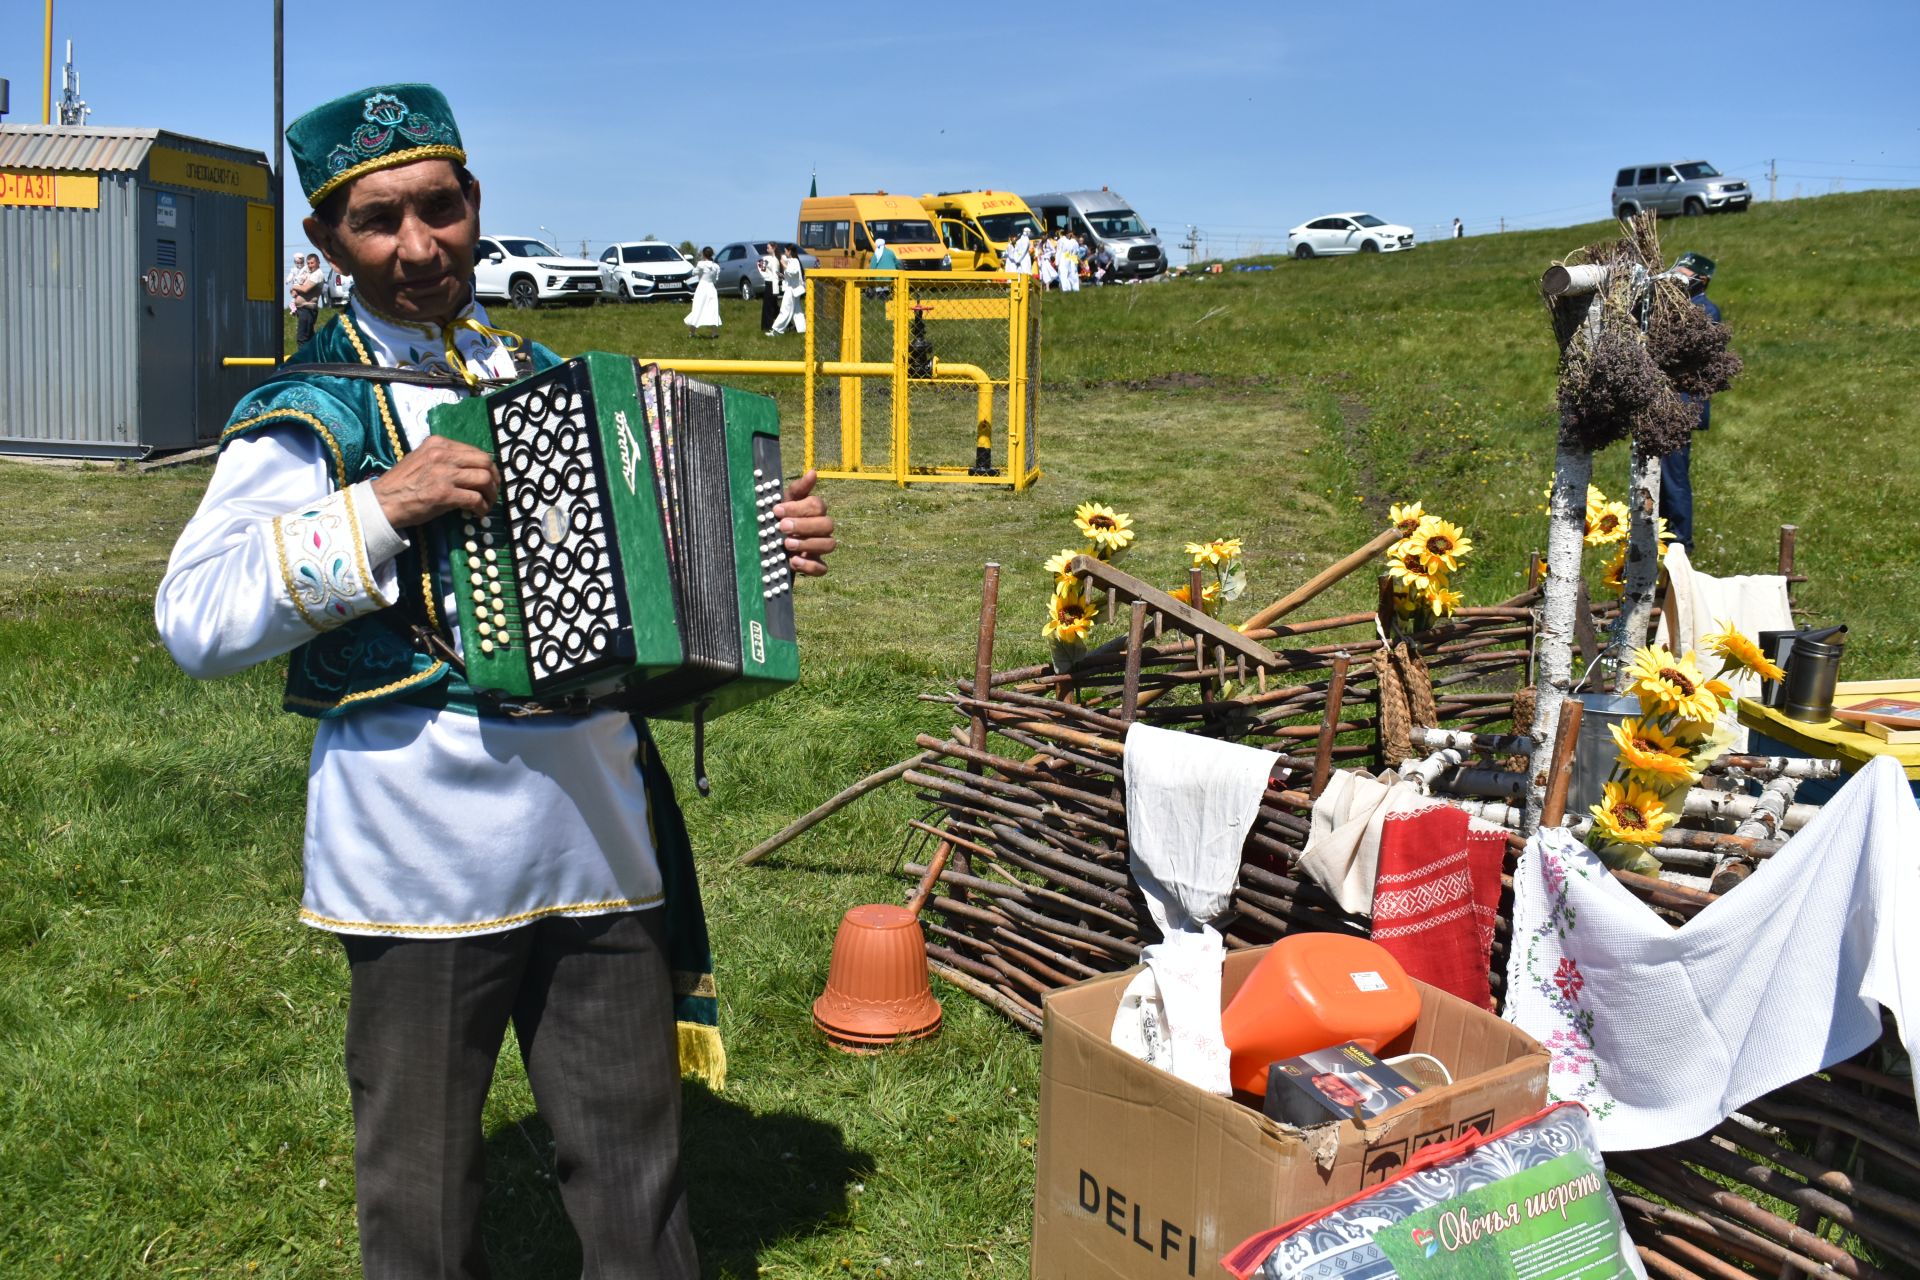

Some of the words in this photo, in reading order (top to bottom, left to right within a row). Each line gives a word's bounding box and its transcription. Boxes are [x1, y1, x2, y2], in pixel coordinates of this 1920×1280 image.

[982, 200, 1016, 209] ДЕТИ
[898, 246, 936, 254] ДЕТИ
[1079, 1168, 1197, 1278] DELFI
[1438, 1205, 1521, 1252] Овечья
[1523, 1171, 1601, 1221] шерсть
